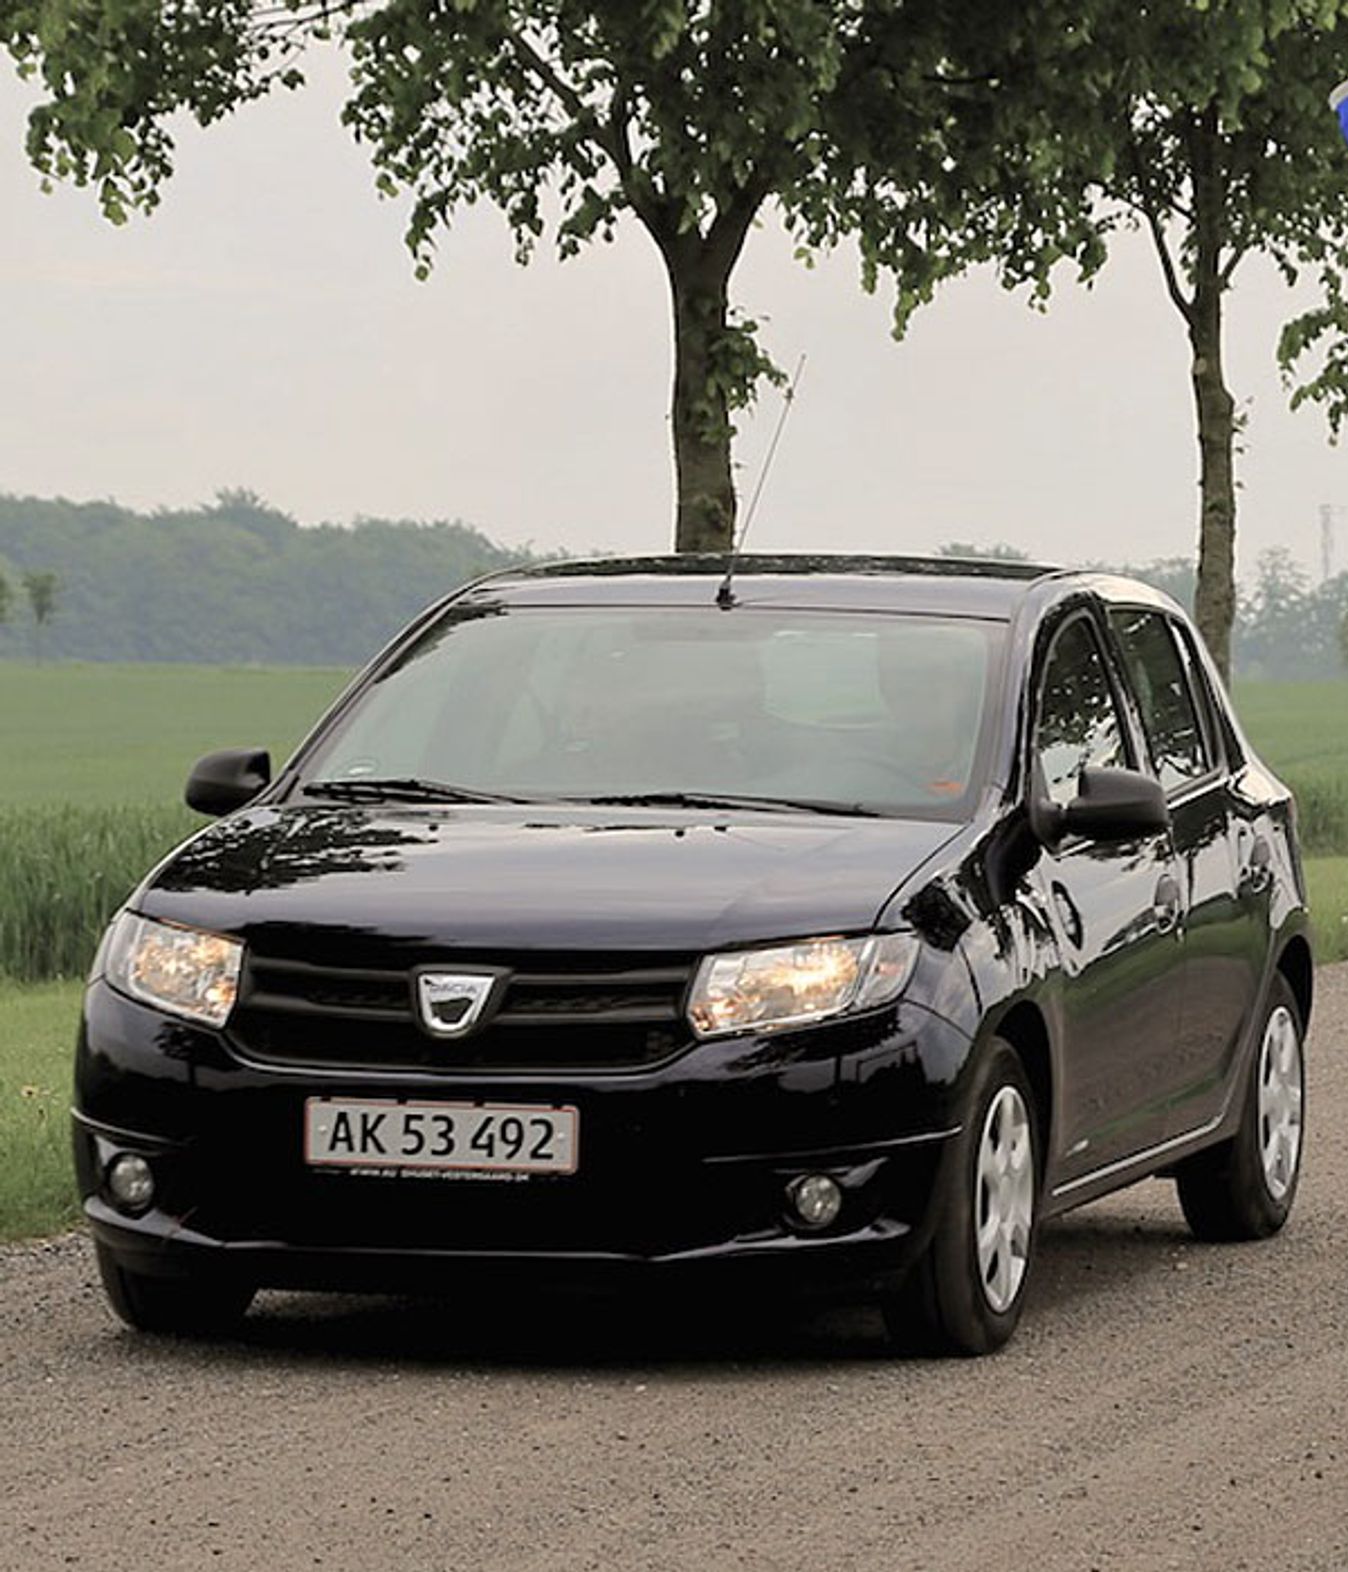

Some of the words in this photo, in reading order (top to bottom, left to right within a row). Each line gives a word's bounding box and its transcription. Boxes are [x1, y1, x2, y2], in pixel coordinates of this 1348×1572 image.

[328, 1111, 388, 1154] AK
[401, 1113, 456, 1157] 53
[469, 1116, 555, 1161] 492
